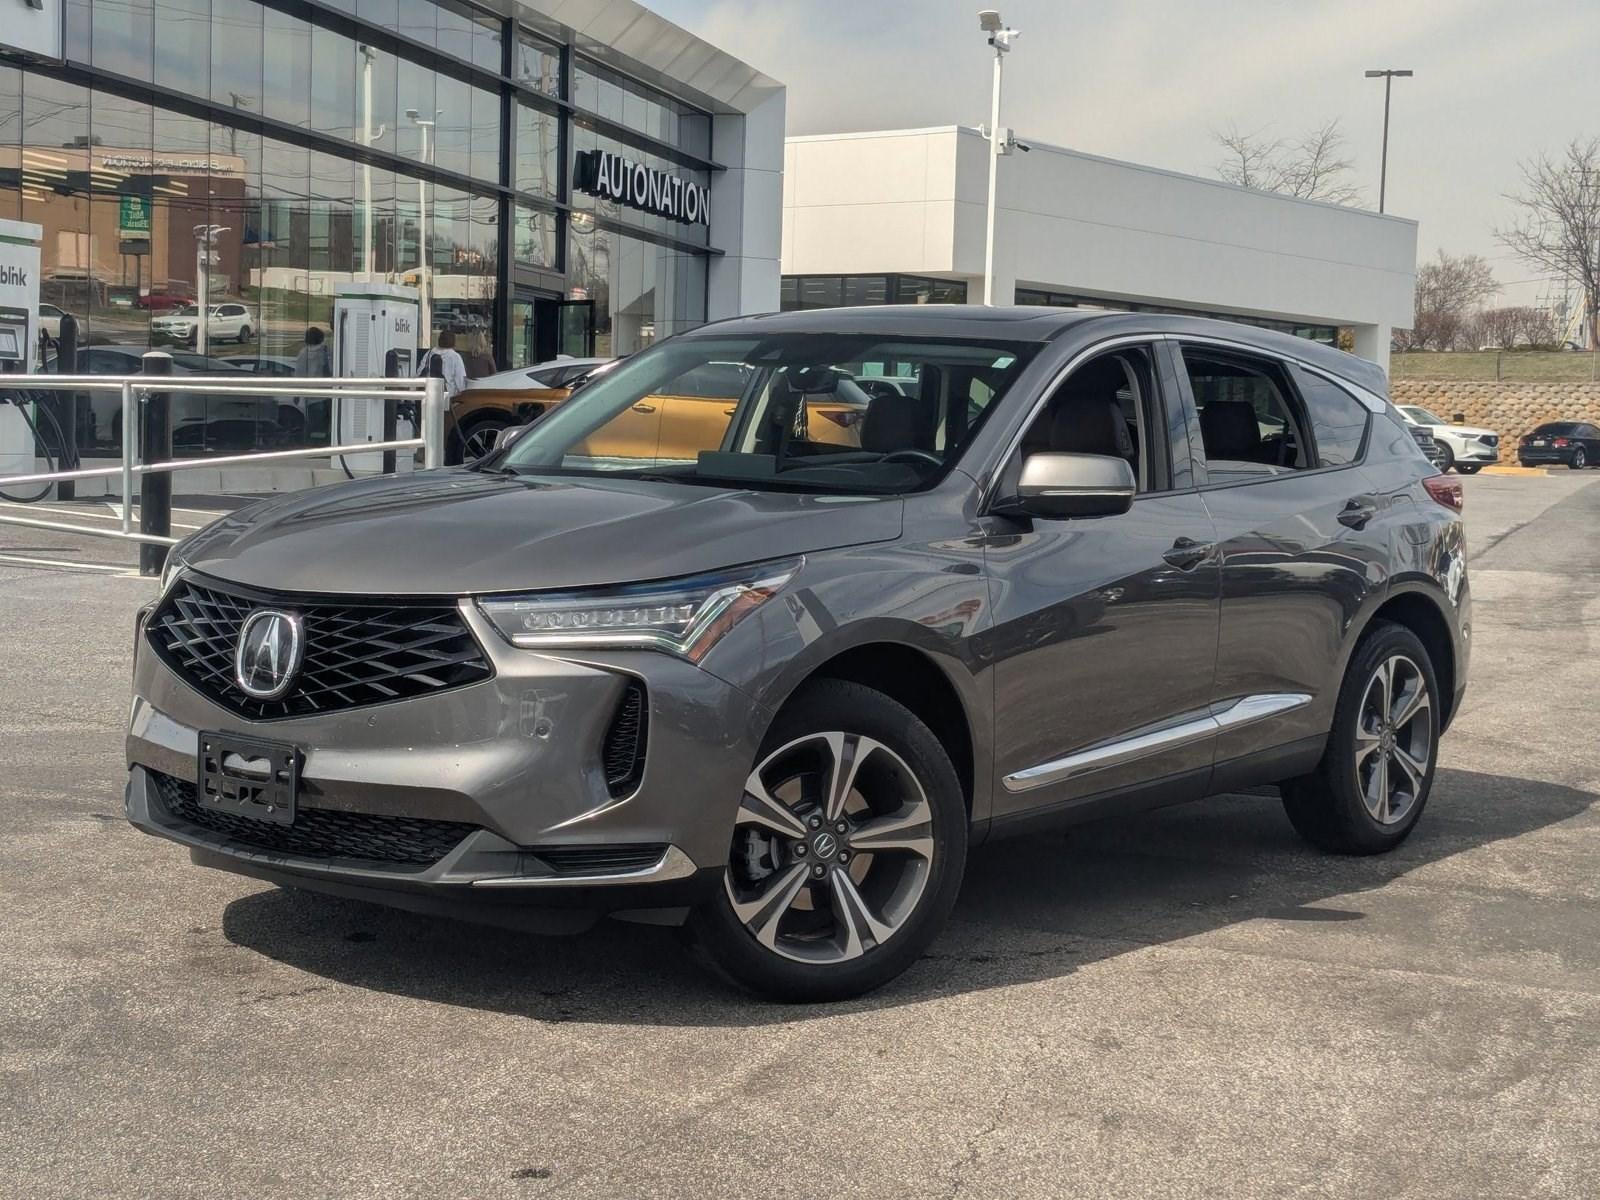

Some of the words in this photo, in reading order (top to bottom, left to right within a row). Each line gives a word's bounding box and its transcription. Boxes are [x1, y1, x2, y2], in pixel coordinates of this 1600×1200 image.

[597, 151, 710, 226] AUTONATION
[1, 265, 27, 287] blink
[394, 318, 410, 333] blink
